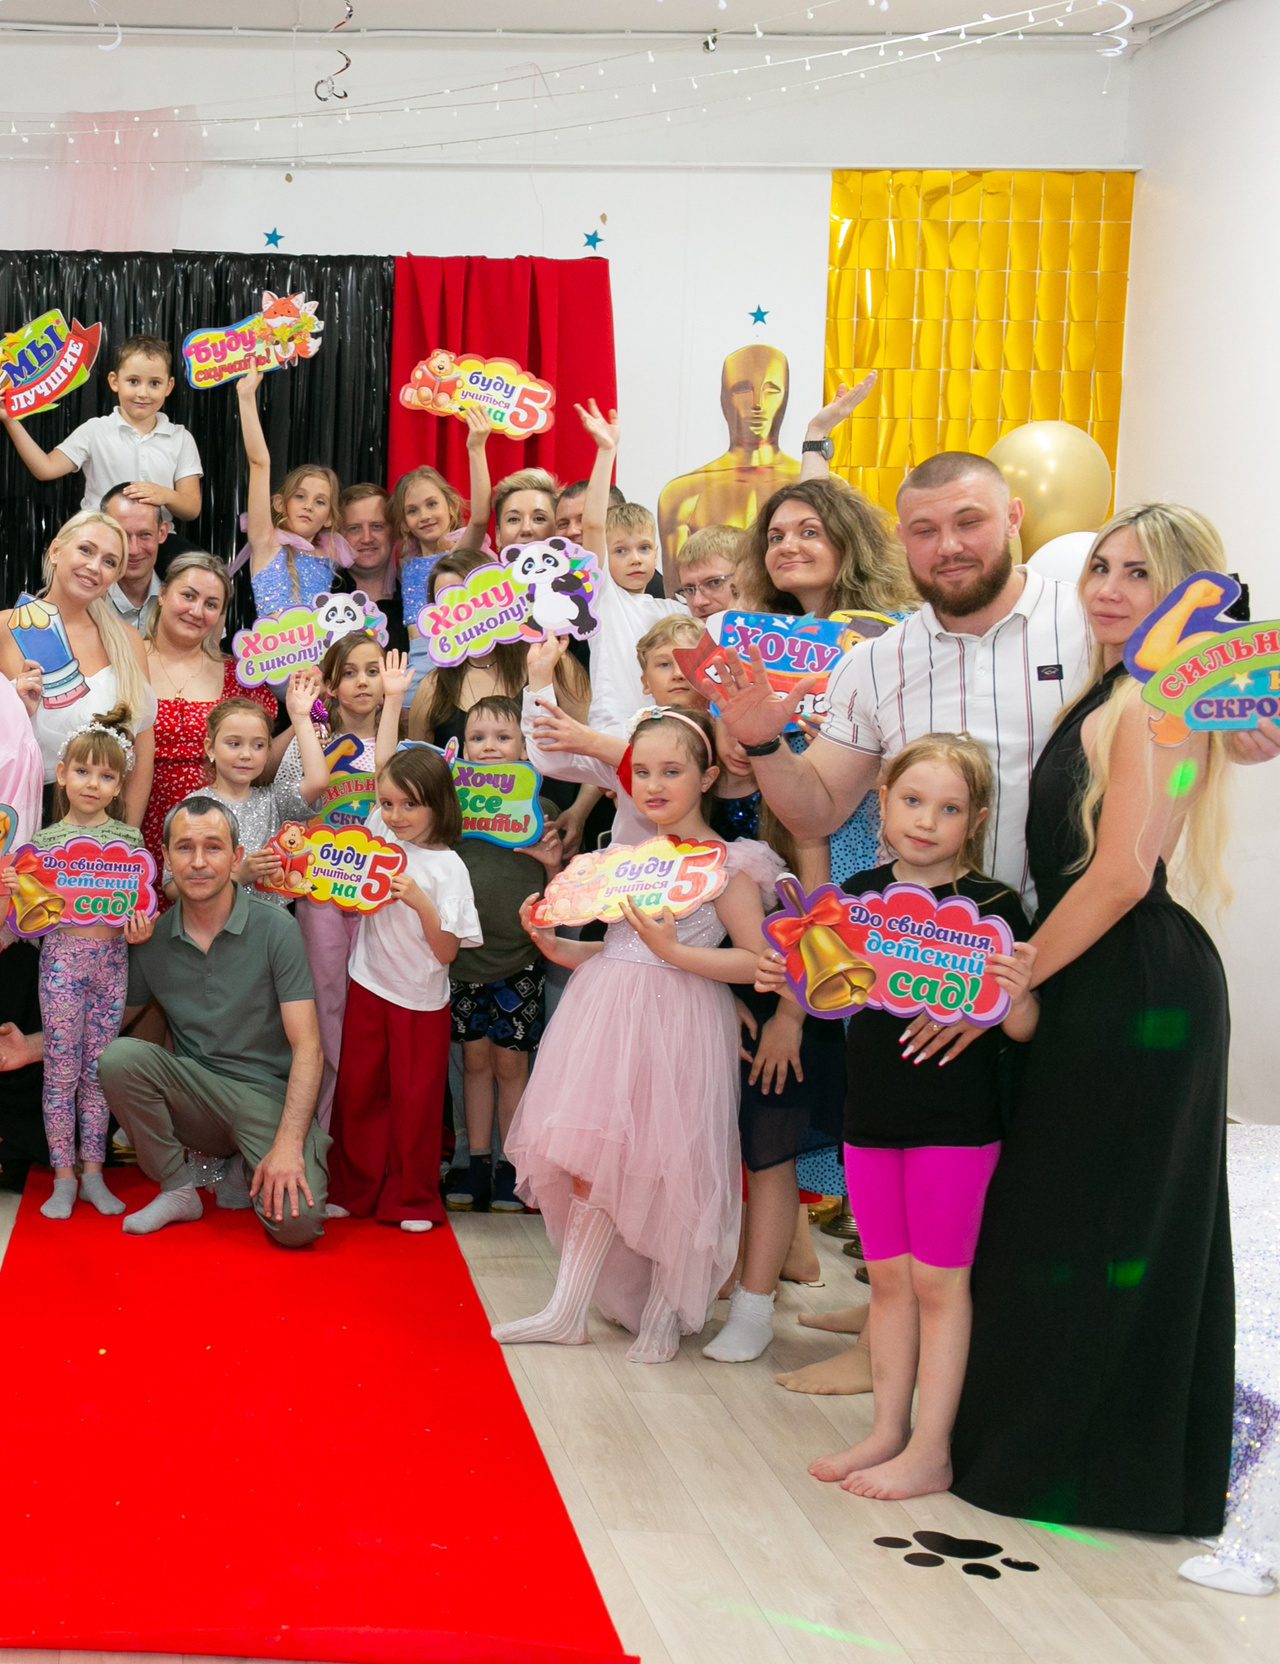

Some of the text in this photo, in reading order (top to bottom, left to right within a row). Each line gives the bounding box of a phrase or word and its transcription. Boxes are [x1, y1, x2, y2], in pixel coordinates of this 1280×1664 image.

[2, 325, 65, 388] МЫ
[184, 329, 256, 363] Буду
[10, 339, 84, 412] ЛУЧШИЕ
[469, 371, 516, 398] буду
[461, 389, 511, 410] учиться
[509, 387, 549, 429] 5
[427, 580, 514, 635] Хочу
[439, 596, 529, 653] в школу!
[242, 623, 314, 658] Хочу
[245, 640, 323, 676] в школу!
[454, 766, 516, 794] Хочу
[462, 813, 531, 834] нать!
[44, 856, 144, 873] До свидания,
[320, 843, 367, 870] буду
[615, 856, 675, 881] буду
[56, 872, 139, 890] детский
[312, 866, 362, 883] учиться
[331, 854, 400, 902] на 5
[604, 880, 669, 898] учиться
[668, 850, 719, 902] 5
[74, 891, 137, 916] сад!
[850, 905, 995, 953] До свидания,
[865, 931, 985, 976] детский
[888, 970, 981, 1013] сад!
